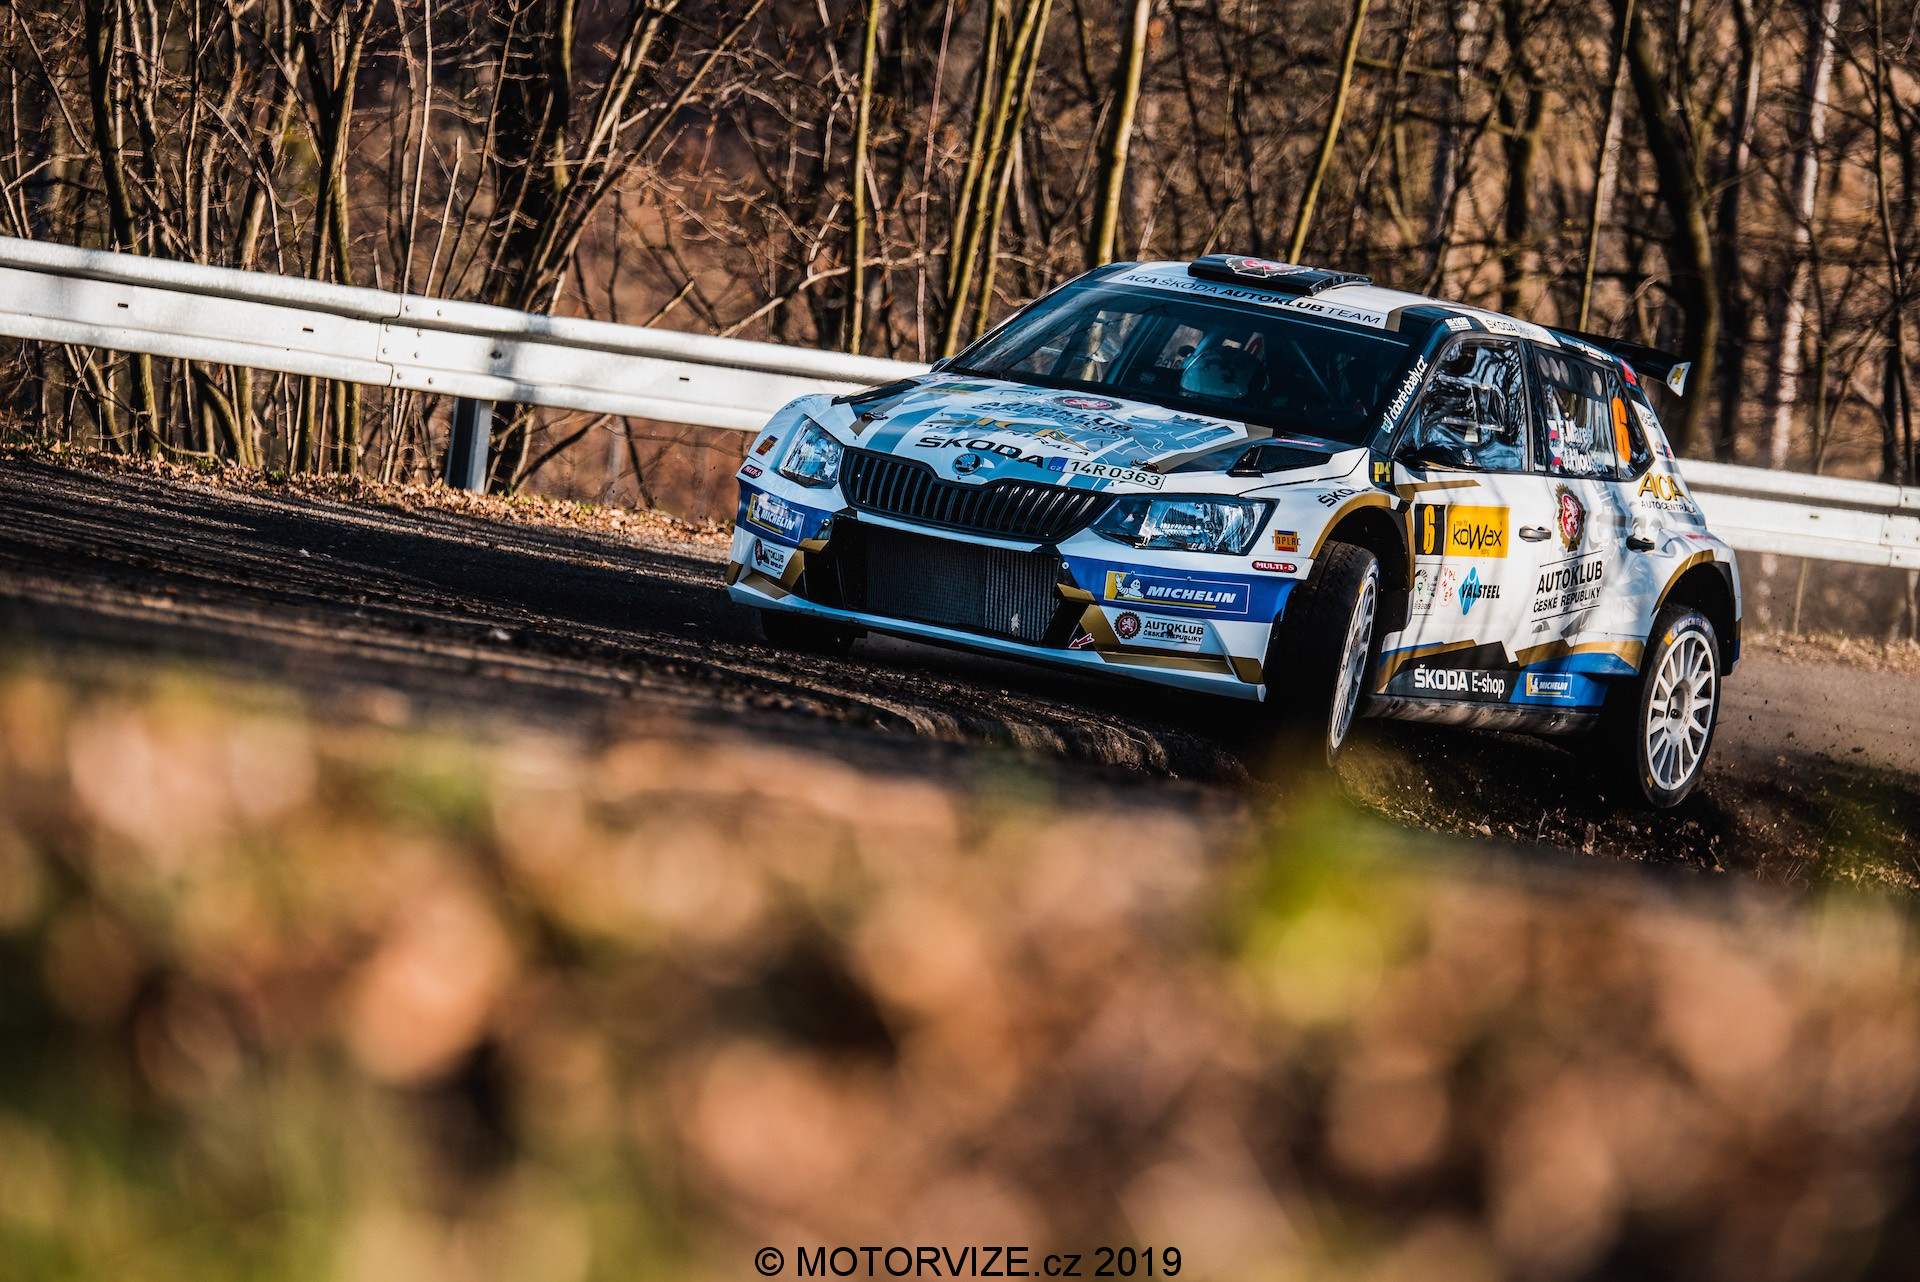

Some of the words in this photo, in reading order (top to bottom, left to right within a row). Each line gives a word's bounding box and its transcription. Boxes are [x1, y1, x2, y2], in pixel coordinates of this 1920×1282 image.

[1124, 274, 1158, 284] ACA
[1158, 277, 1218, 294] ŠKODA
[1219, 288, 1326, 312] AUTOKLUB
[1327, 307, 1381, 325] TEAM
[1612, 397, 1631, 462] 6
[914, 434, 1045, 469] ŠKODA
[1069, 460, 1106, 478] 14R
[1107, 466, 1162, 487] 0363
[1637, 472, 1691, 504] ACA
[761, 509, 796, 531] MICHELIN
[1423, 505, 1436, 555] 6
[1452, 523, 1503, 550] koWax
[1461, 583, 1501, 599] VALSTEEL
[1536, 560, 1603, 595] AUTOKLUB
[1146, 585, 1237, 604] MICHELIN
[1533, 592, 1559, 613] ČESKÉ
[1560, 585, 1602, 607] REPUBLIKY
[1143, 629, 1165, 638] ČESKÉ
[1145, 620, 1204, 635] AUTOKLUB
[1414, 663, 1469, 692] ŠKODA
[1471, 671, 1506, 699] E-shop
[1538, 678, 1569, 691] MICHELIN
